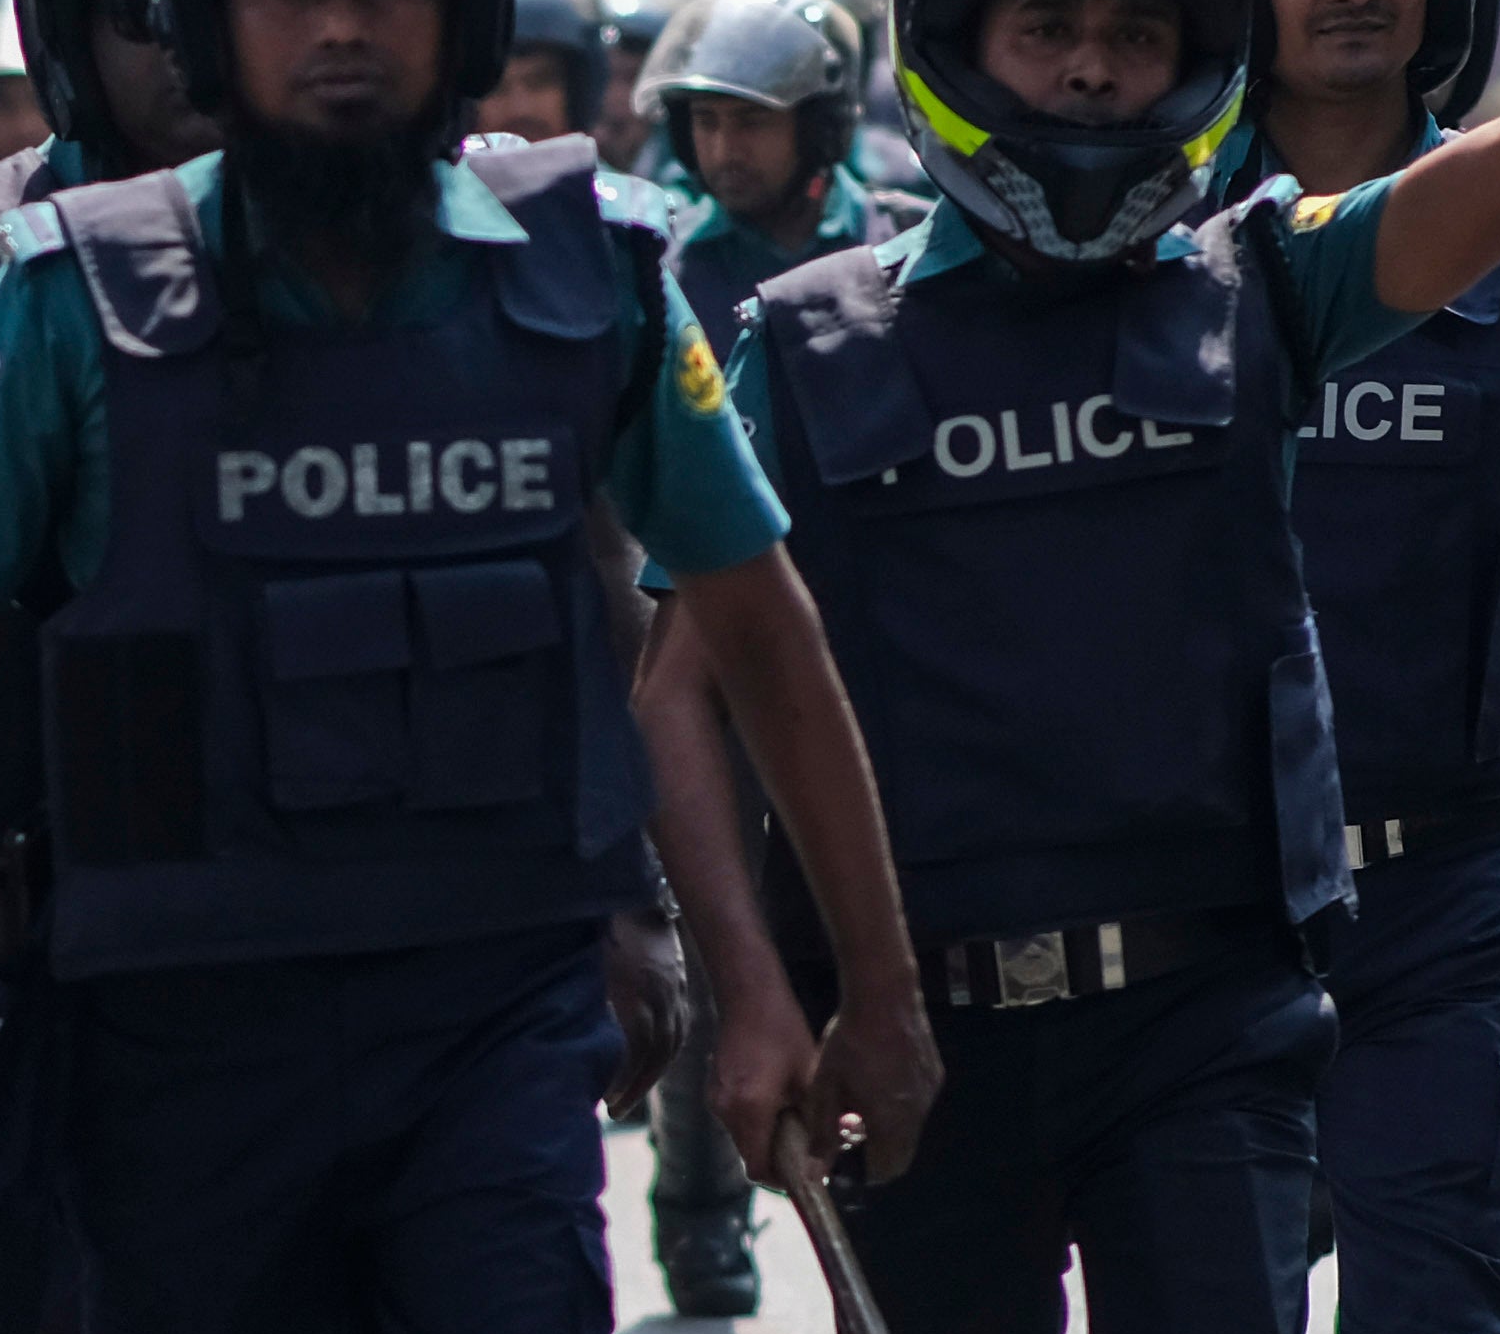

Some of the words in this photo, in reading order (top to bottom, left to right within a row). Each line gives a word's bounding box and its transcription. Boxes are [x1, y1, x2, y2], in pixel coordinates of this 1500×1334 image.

[881, 394, 1195, 485] OLIC
[1296, 381, 1446, 441] ICE
[216, 438, 556, 523] POLICE
